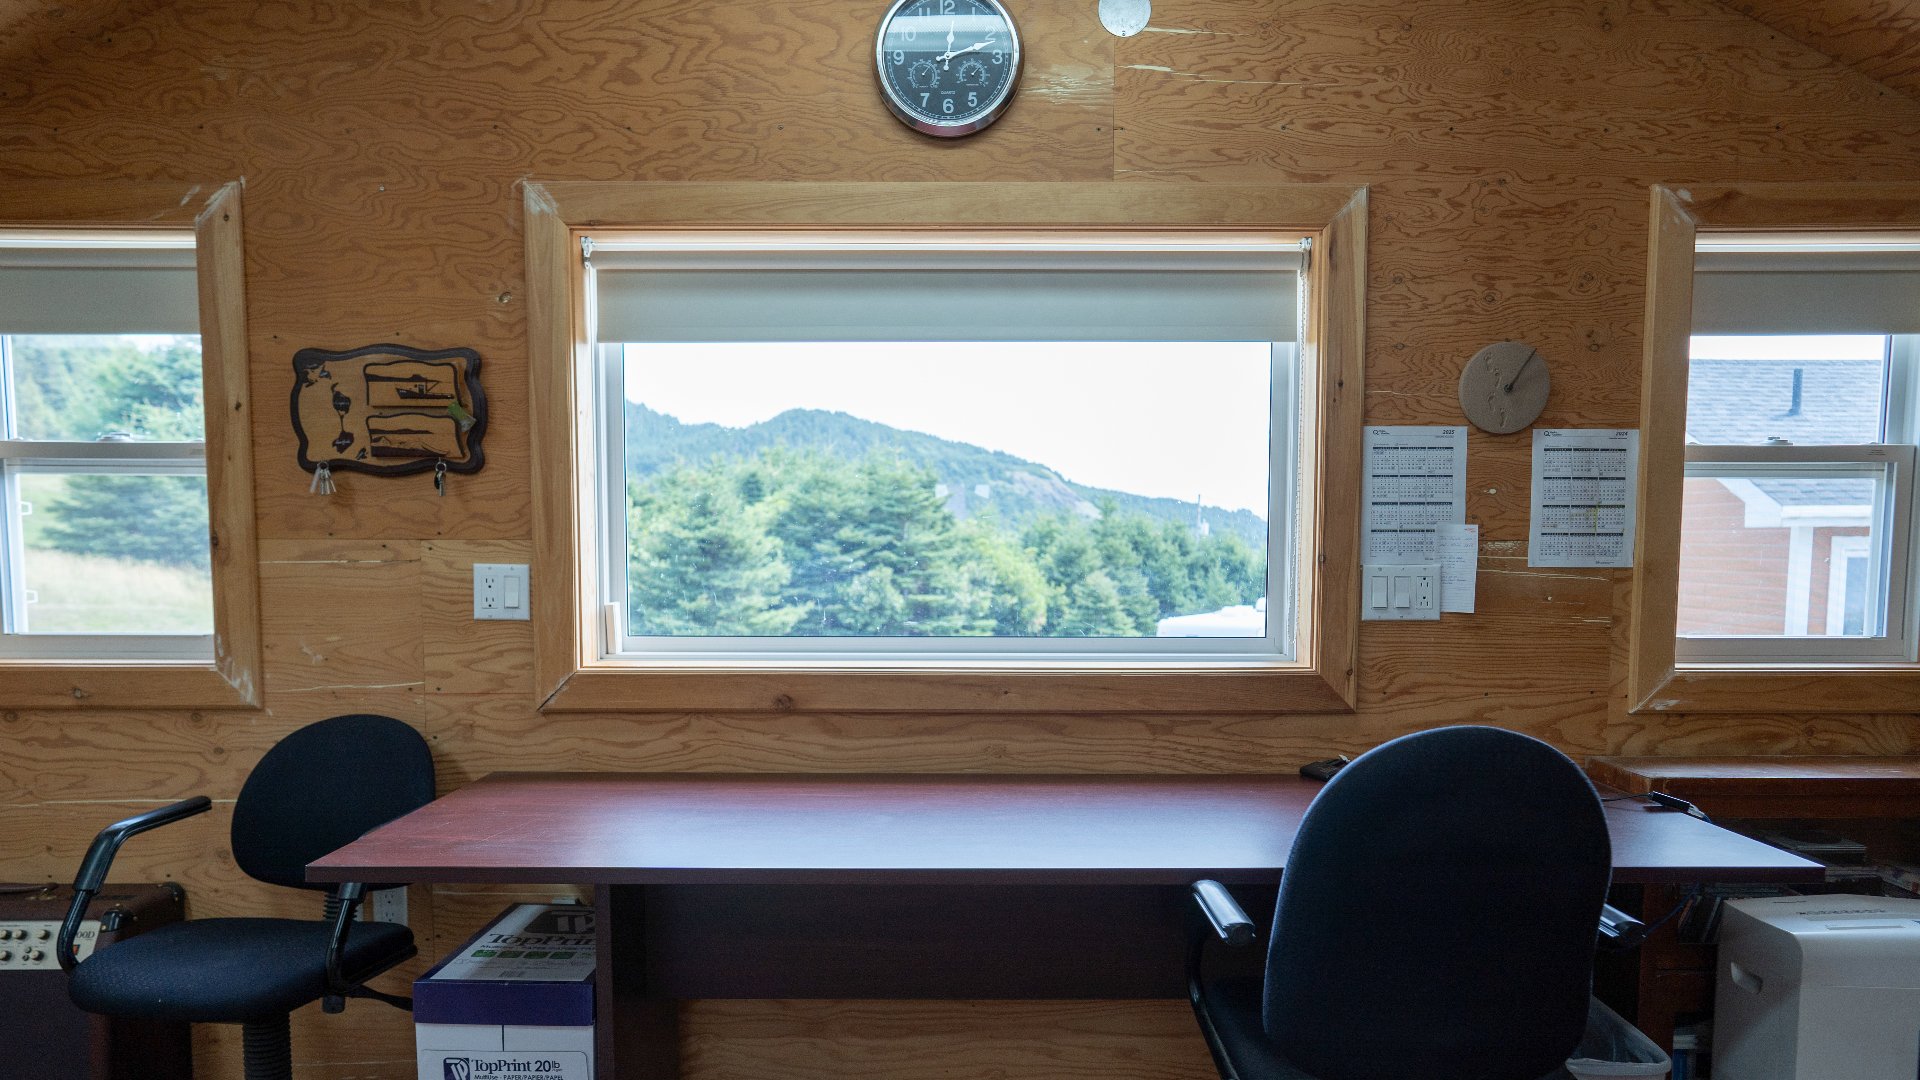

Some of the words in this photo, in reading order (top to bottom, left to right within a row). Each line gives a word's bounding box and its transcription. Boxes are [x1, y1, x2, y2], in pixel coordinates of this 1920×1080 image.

[940, 0, 956, 15] 12
[901, 27, 916, 42] 10
[984, 26, 997, 41] 2
[893, 50, 905, 65] 9
[992, 50, 1003, 65] 3
[920, 92, 930, 108] 7
[942, 99, 954, 113] 6
[967, 92, 977, 107] 5
[489, 934, 595, 946] TopPri
[472, 1058, 532, 1074] TopPrint
